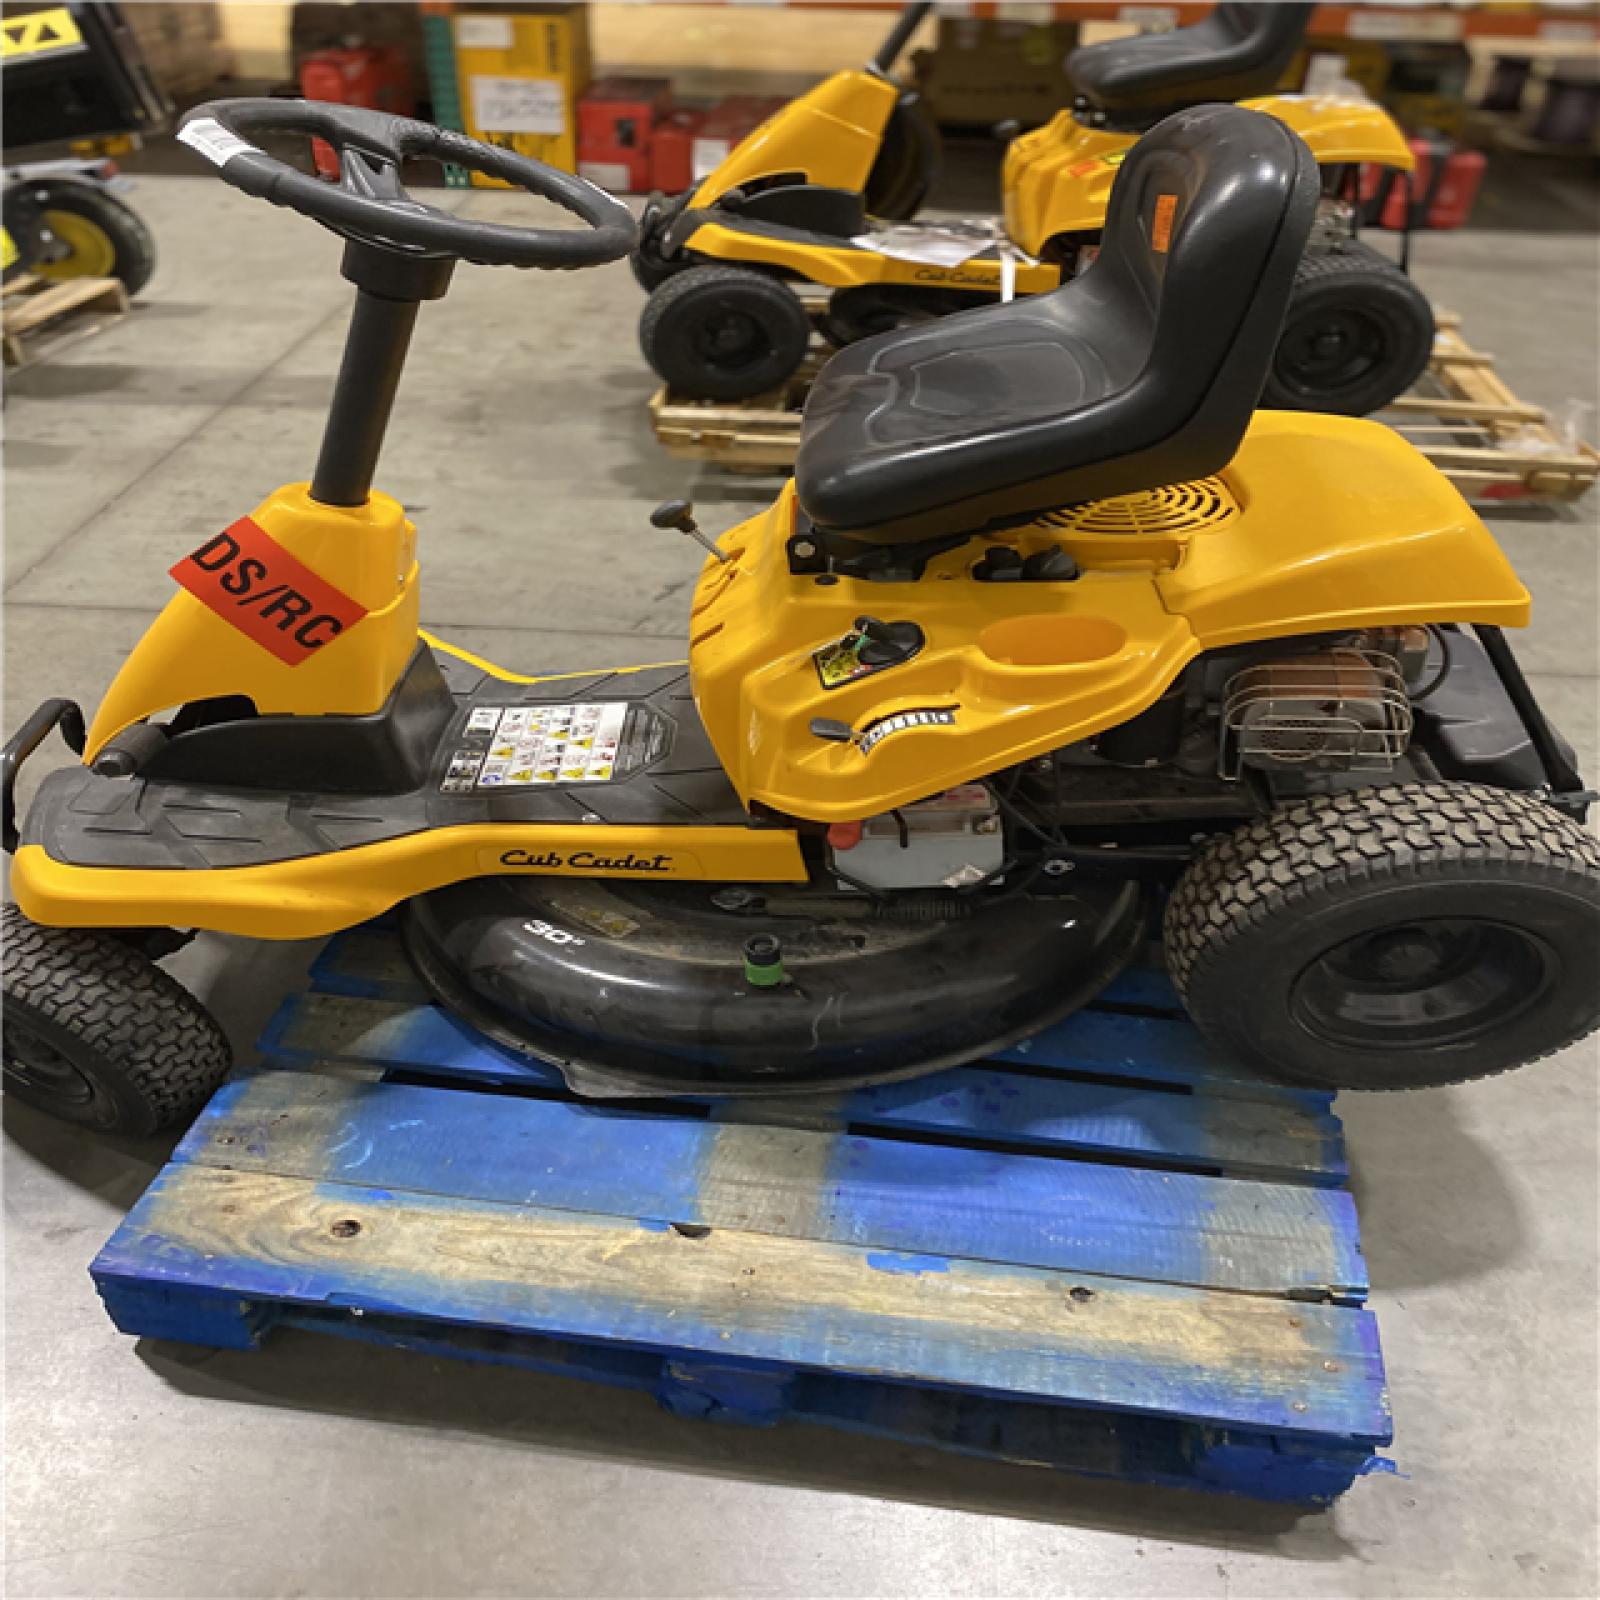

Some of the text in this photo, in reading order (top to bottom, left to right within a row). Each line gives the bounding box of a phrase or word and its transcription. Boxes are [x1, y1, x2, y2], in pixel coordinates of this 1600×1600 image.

[190, 532, 342, 648] DS/RC
[499, 850, 673, 871] Cub Cadet
